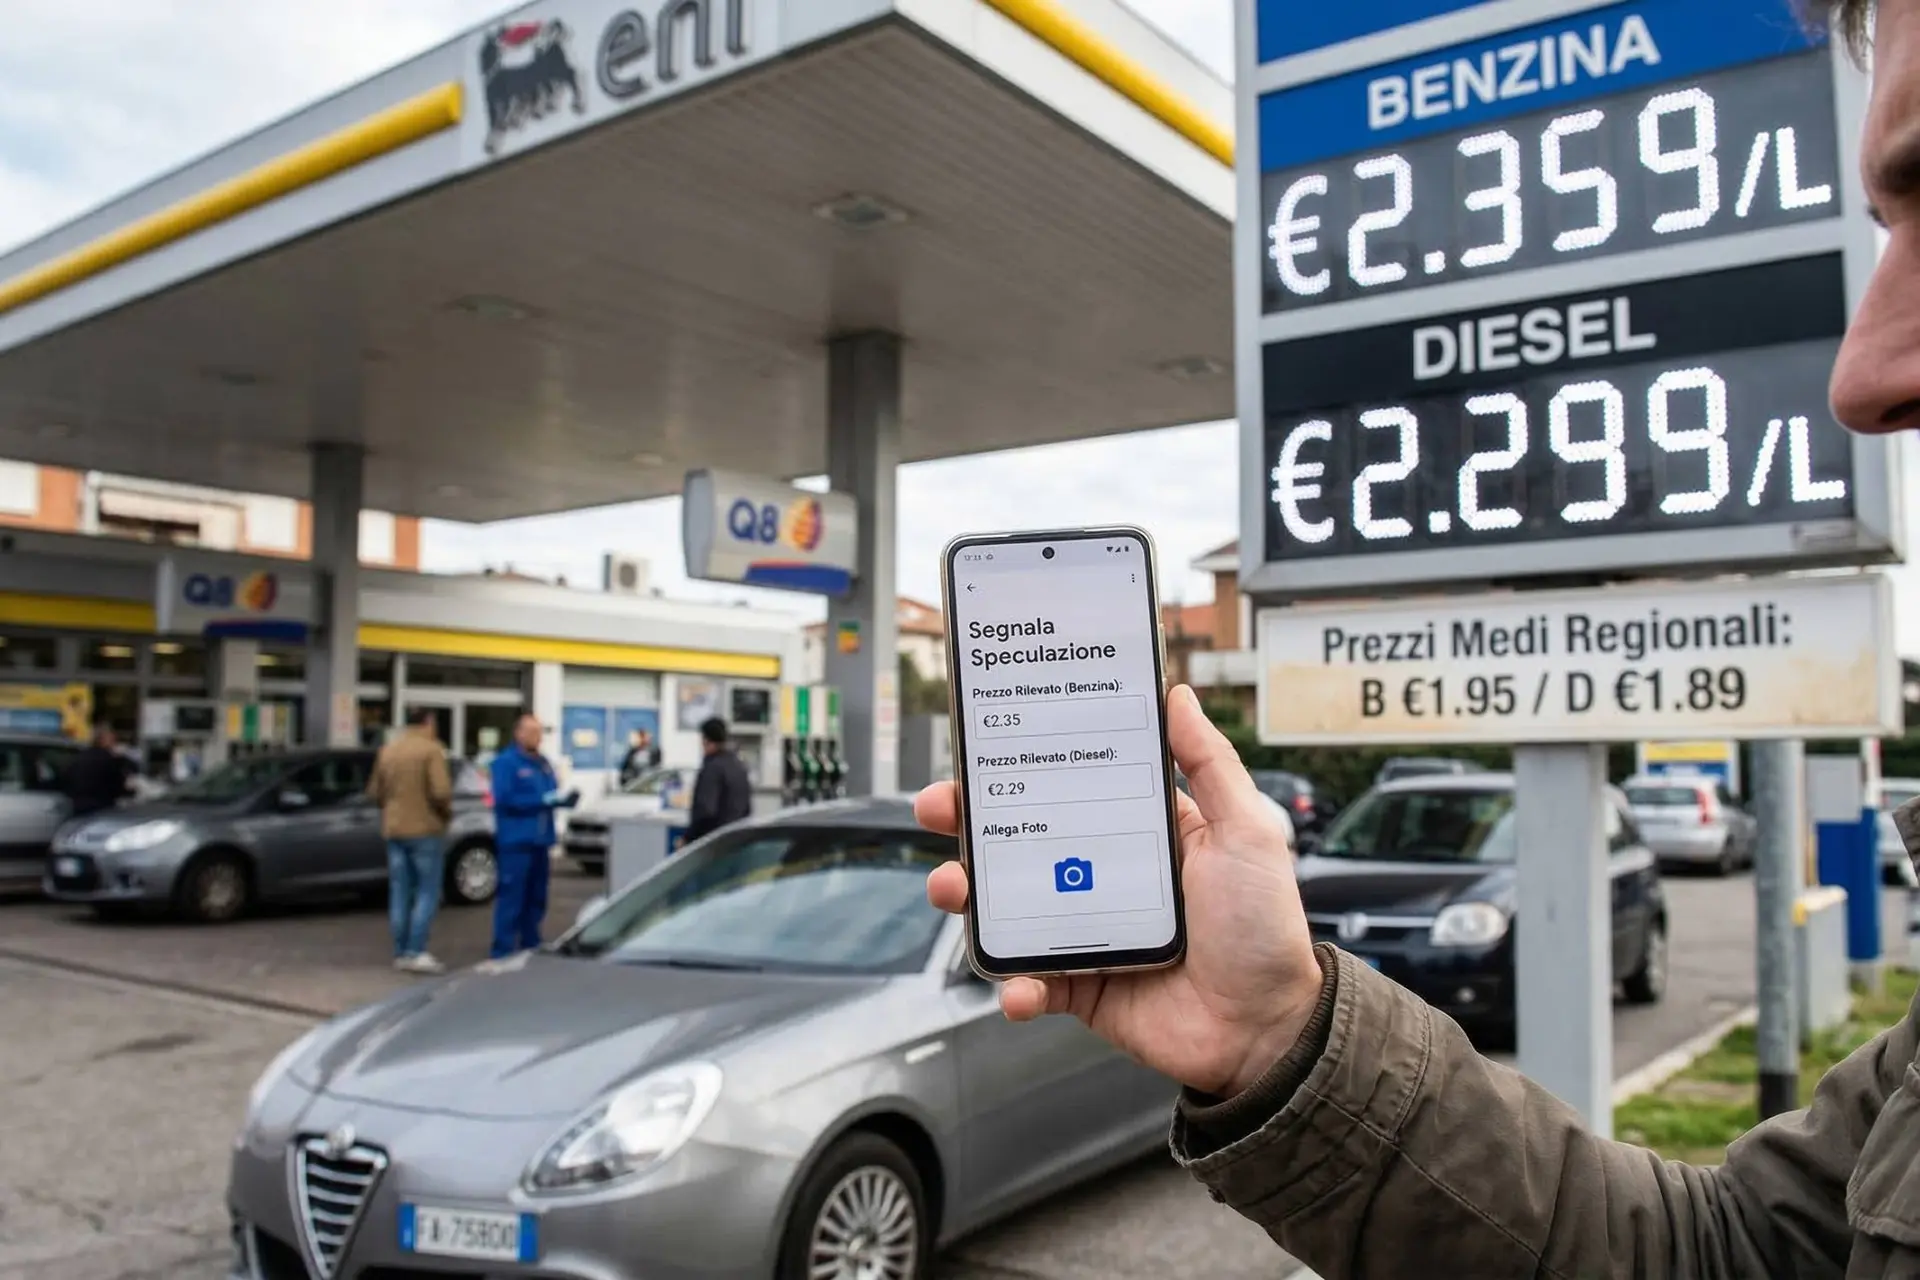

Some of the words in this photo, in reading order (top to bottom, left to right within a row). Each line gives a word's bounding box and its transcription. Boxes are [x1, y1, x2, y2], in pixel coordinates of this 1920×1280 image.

[1367, 14, 1661, 130] BENZINA
[1413, 297, 1656, 380] DIESEL
[727, 497, 779, 544] Q8
[968, 618, 1056, 642] Segnala
[1323, 622, 1436, 665] Prezzi
[1452, 618, 1549, 657] Medi
[1566, 603, 1793, 661] Regionali:
[971, 642, 1117, 671] Speculazione
[972, 688, 1013, 699] Prezzo
[1015, 684, 1062, 697] Rilevato
[1064, 679, 1123, 695] (Benzina):
[1361, 680, 1384, 718] B
[1403, 674, 1516, 716] €1.95
[1567, 673, 1595, 713] D
[1614, 666, 1748, 712] €1.89
[983, 713, 1021, 728] €2.35
[977, 755, 1017, 767] Prezzo
[1020, 752, 1067, 765] Rilevato
[1069, 747, 1118, 763] (Diesel):
[988, 781, 1026, 796] €2.29
[982, 824, 1019, 836] Allega
[1022, 822, 1048, 833] Foto
